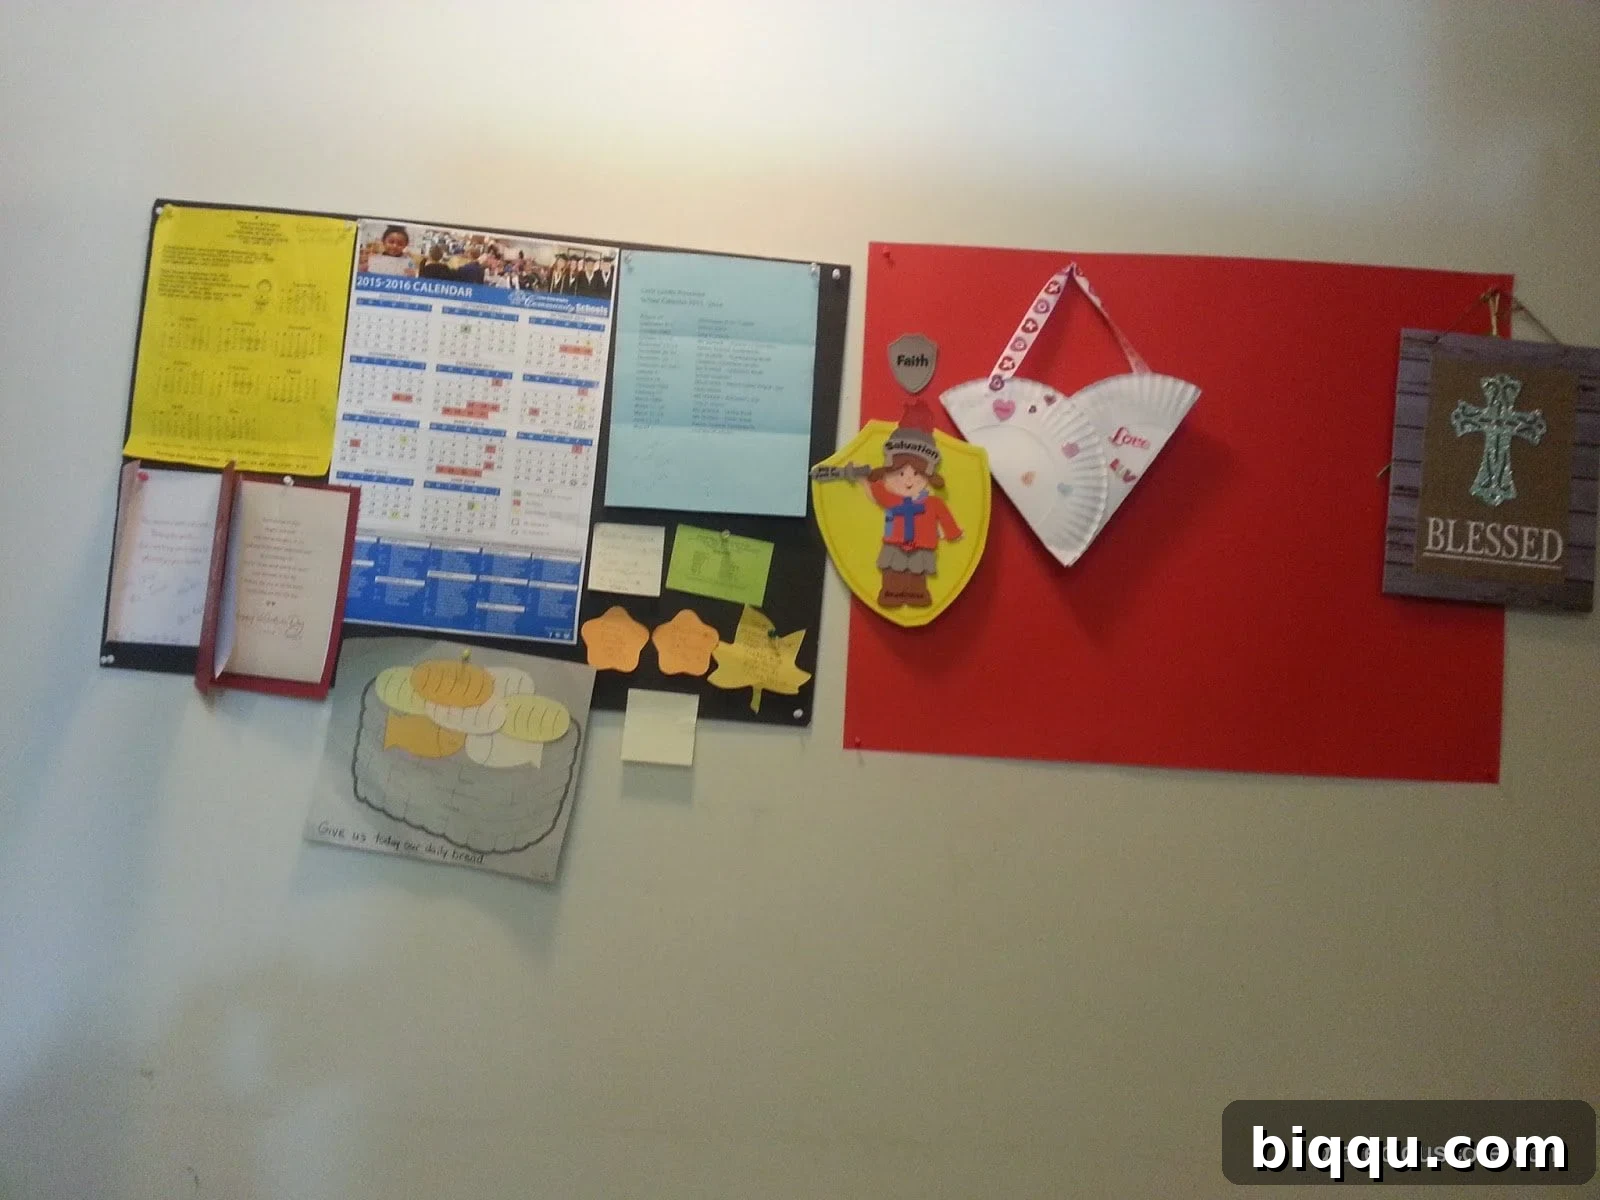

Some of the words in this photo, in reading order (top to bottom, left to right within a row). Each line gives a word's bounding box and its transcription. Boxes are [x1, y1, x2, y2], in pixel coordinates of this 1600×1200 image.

[357, 276, 411, 290] 2015-2016
[413, 281, 473, 298] CALENDAR
[897, 354, 929, 367] Faith
[885, 441, 938, 459] Salvation
[1425, 516, 1564, 563] BLESSED
[352, 832, 366, 841] us
[452, 849, 484, 864] bread
